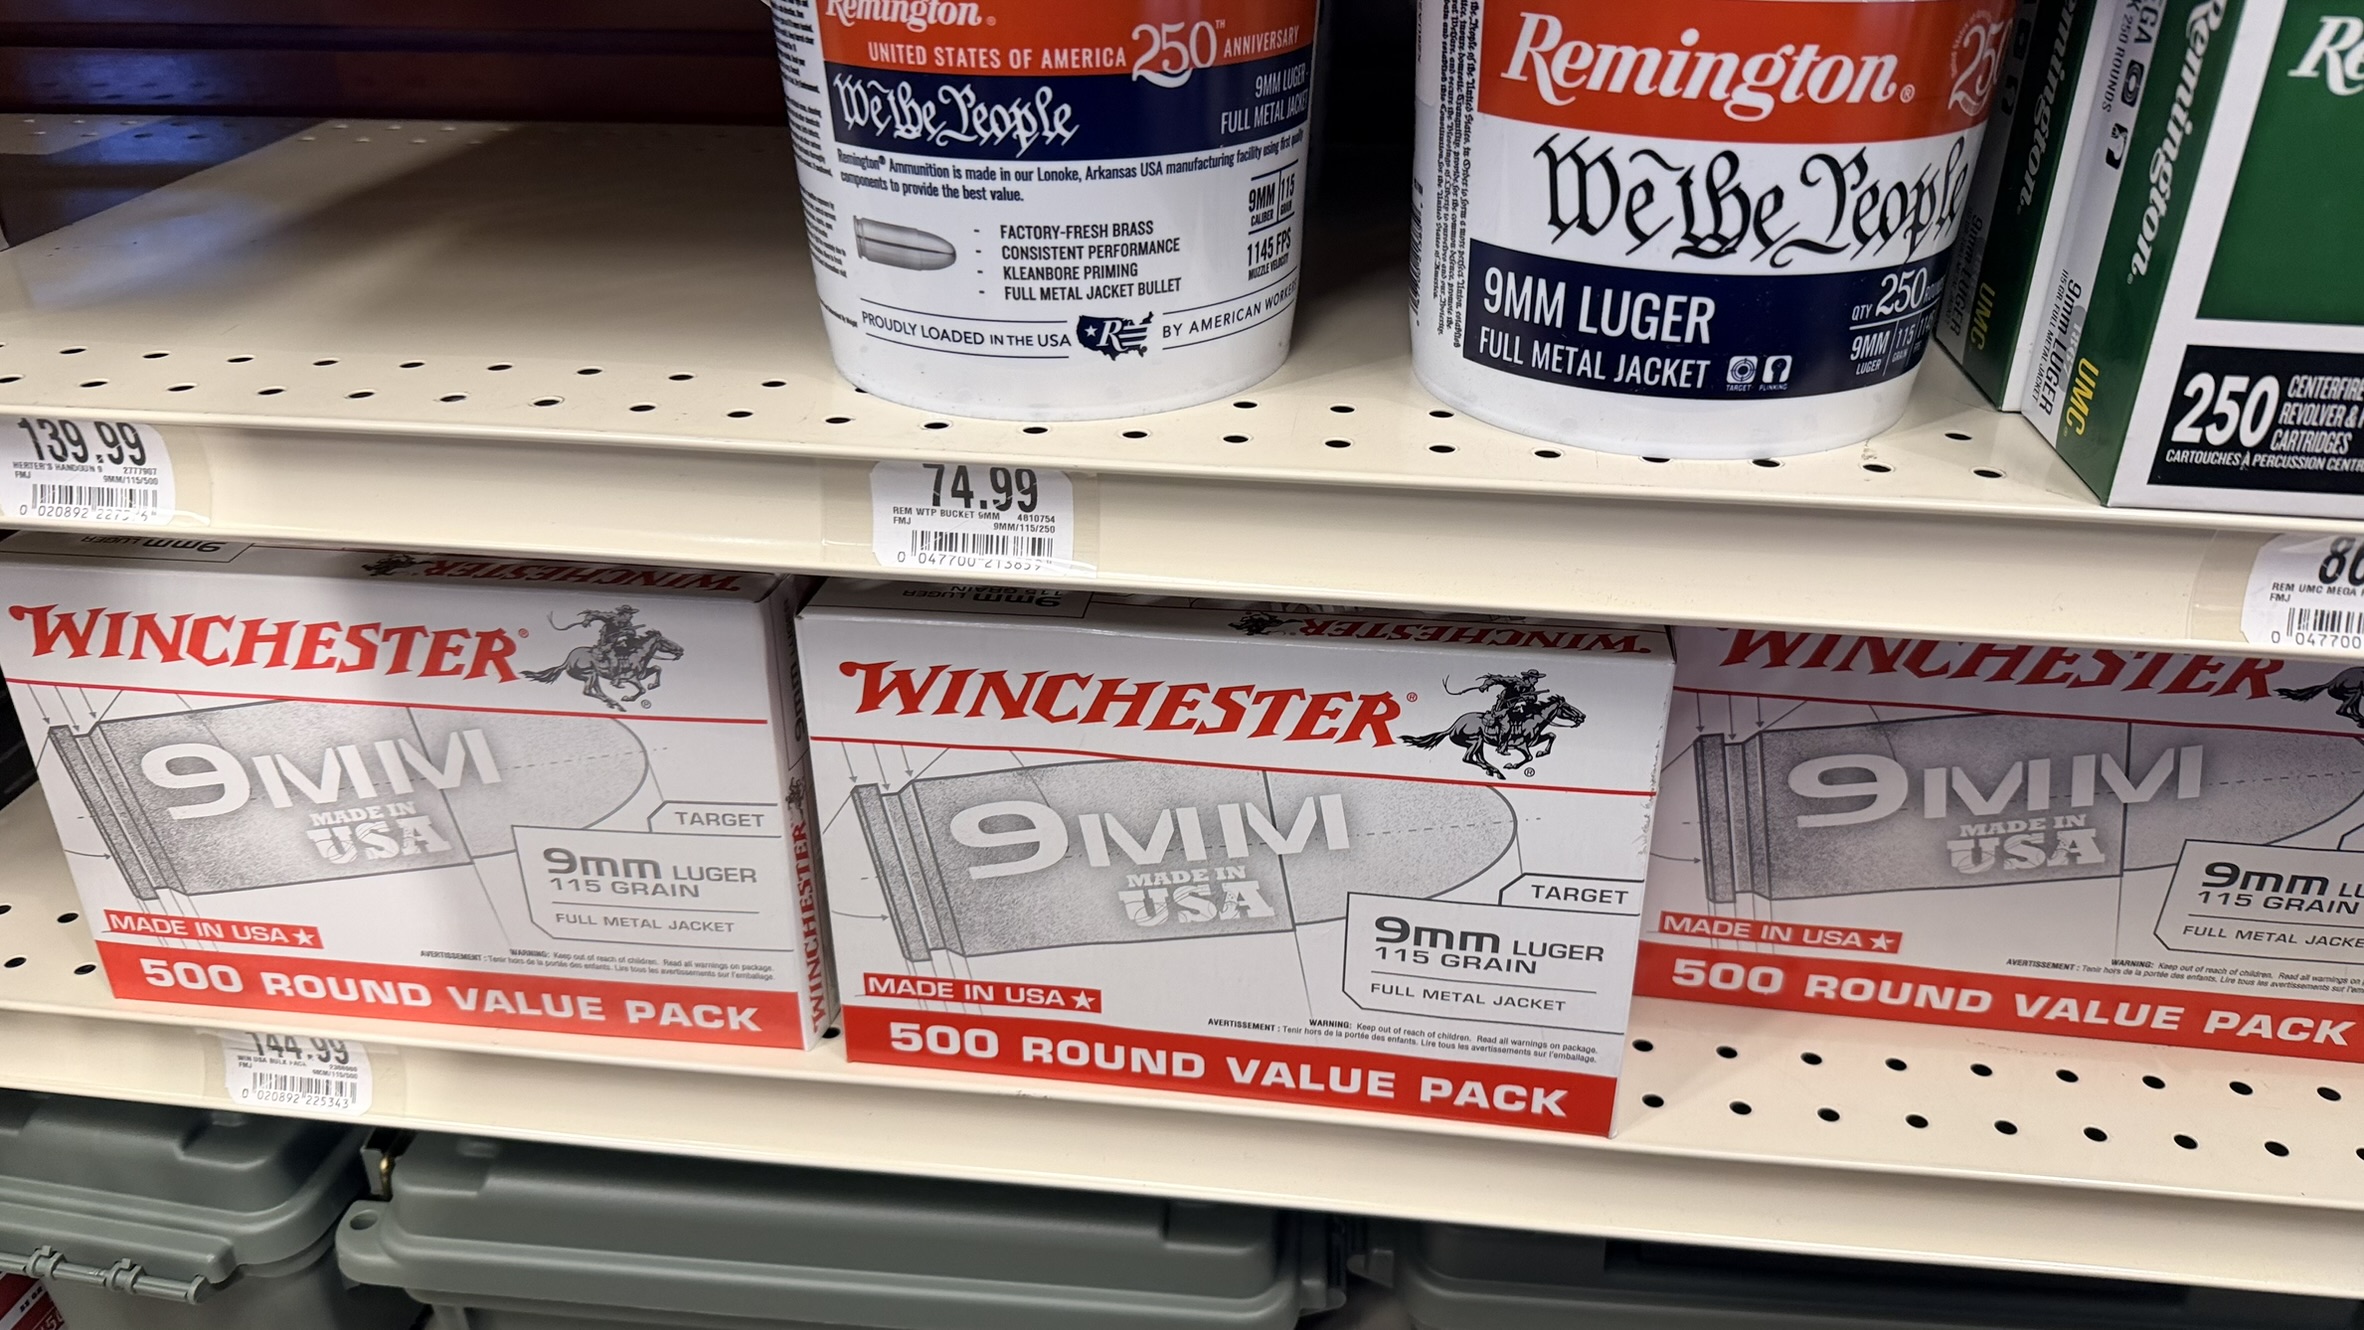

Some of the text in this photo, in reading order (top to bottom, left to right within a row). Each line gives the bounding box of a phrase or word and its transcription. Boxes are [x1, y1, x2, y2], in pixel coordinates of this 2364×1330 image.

[826, 0, 982, 32] Remington
[868, 42, 927, 66] UNITED
[934, 46, 1001, 69] STATES
[1009, 49, 1032, 69] OF
[1041, 47, 1126, 69] AMERICA
[1131, 20, 1218, 88] 250
[1224, 25, 1299, 58] ANNIVERSARY
[1500, 11, 1897, 121] Remington
[833, 73, 892, 136] We
[936, 84, 1080, 158] People
[889, 158, 949, 179] Ammunition
[953, 165, 962, 179] is
[965, 166, 996, 181] made
[1000, 167, 1011, 181] in
[1015, 170, 1032, 181] our
[1038, 167, 1082, 183] Lonoke,
[1085, 166, 1137, 181] Arkansas
[1141, 162, 1162, 177] USA
[1166, 153, 1235, 175] manufacturing
[1236, 145, 1261, 163] facility
[841, 171, 1023, 202] components to provide the best value.
[1532, 132, 1686, 255] We
[1771, 137, 1970, 268] People
[1000, 220, 1154, 240] FACTORY-FRESH BRASS
[1001, 237, 1180, 261] CONSISTENT PERFORMANCE
[1003, 262, 1138, 280] KLEANBORE PRIMING
[1004, 277, 1182, 300] FULL METAL JACKET BULLET
[1851, 303, 1873, 321] QTY
[1875, 267, 1927, 317] 250
[1483, 267, 1715, 345] 9MM LUGER
[1970, 282, 1995, 350] UMC
[862, 311, 917, 338] PROUDLY
[921, 324, 985, 345] LOADED
[989, 334, 1004, 346] IN
[1006, 335, 1034, 347] THE
[1037, 333, 1072, 347] USA
[1101, 319, 1130, 352] R
[1162, 324, 1183, 339] BY
[1188, 302, 1261, 334] AMERICAN
[1478, 325, 1711, 389] FULL METAL JACKET
[2039, 279, 2082, 416] 9mm LUGER
[2066, 357, 2099, 436] UMC
[2171, 372, 2280, 448] 250
[2278, 402, 2358, 428] REVOLVER &
[17, 417, 146, 466] 139.99
[2270, 428, 2353, 455] CARTRIDGES
[15, 471, 159, 485] FMJ 9MM/115/500
[922, 463, 1038, 513] 74.99
[19, 504, 28, 516] 0
[38, 505, 89, 519] 020892
[893, 506, 1055, 523] REM WTP BUCKET 9MM 4810754
[893, 516, 1055, 534] FMJ 9MM/115/250
[424, 559, 741, 592] WINCHESTER
[897, 551, 976, 567] 0 047700
[2269, 593, 2291, 602] FMJ
[2272, 582, 2295, 592] REM
[2298, 584, 2323, 594] UMC
[9, 604, 522, 684] WINCHESTER
[1301, 618, 1651, 655] WINCHESTER
[2271, 631, 2361, 649] 0 047700
[1719, 628, 2285, 699] WINCHESTER
[840, 660, 1403, 748] WINCHESTER
[141, 729, 501, 820] 9MM
[1788, 744, 2204, 828] 9MM
[311, 800, 417, 828] MADE IN
[675, 811, 765, 828] TARGET
[1959, 813, 2087, 838] MADE IN
[305, 814, 453, 865] USA
[950, 793, 1350, 880] 9MM
[1947, 828, 2105, 874] USA
[543, 847, 758, 883] 9mm LUGER
[1125, 865, 1247, 888] MADE IN
[550, 877, 700, 898] 115 GRAIN
[1117, 880, 1275, 927] USA
[1531, 884, 1629, 905] TARGET
[2198, 891, 2359, 914] 115 GRAIN
[109, 913, 290, 943] MADE IN USA
[556, 913, 735, 933] FULL METAL JACKET
[791, 820, 828, 1034] WINCHESTER
[1375, 916, 1604, 962] 9mm LUGER
[1664, 915, 1862, 947] MADE IN USA
[1375, 946, 1537, 975] 115 GRAIN
[139, 958, 763, 1032] 500 ROUND VALUE PACK
[868, 976, 1066, 1007] MADE IN USA
[1371, 983, 1566, 1011] FULL METAL JACKET
[1672, 957, 2356, 1046] 500 ROUND VALUE PACK
[245, 1032, 349, 1064] 144.99
[890, 1021, 1568, 1118] 500 ROUND VALUE PACK
[241, 1088, 349, 1109] 0 020892 225343
